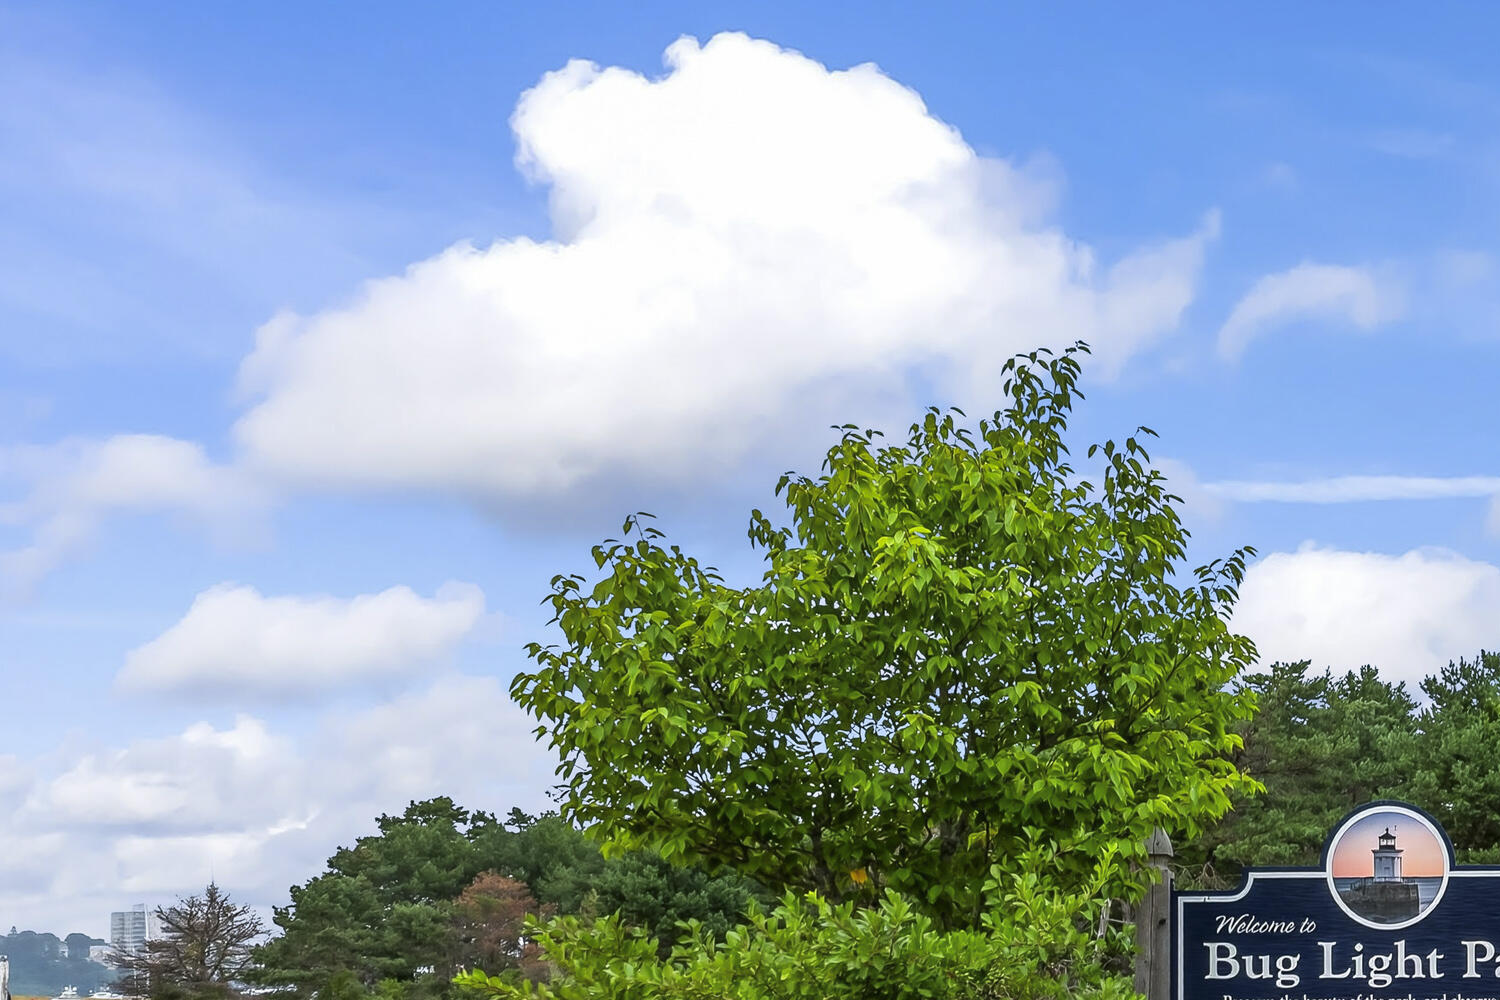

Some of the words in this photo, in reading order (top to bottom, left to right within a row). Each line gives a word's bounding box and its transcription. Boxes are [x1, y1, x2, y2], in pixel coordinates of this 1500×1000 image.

[1215, 913, 1296, 934] Welcome
[1299, 916, 1317, 934] to
[1202, 942, 1301, 989] Bug
[1317, 939, 1445, 989] Light
